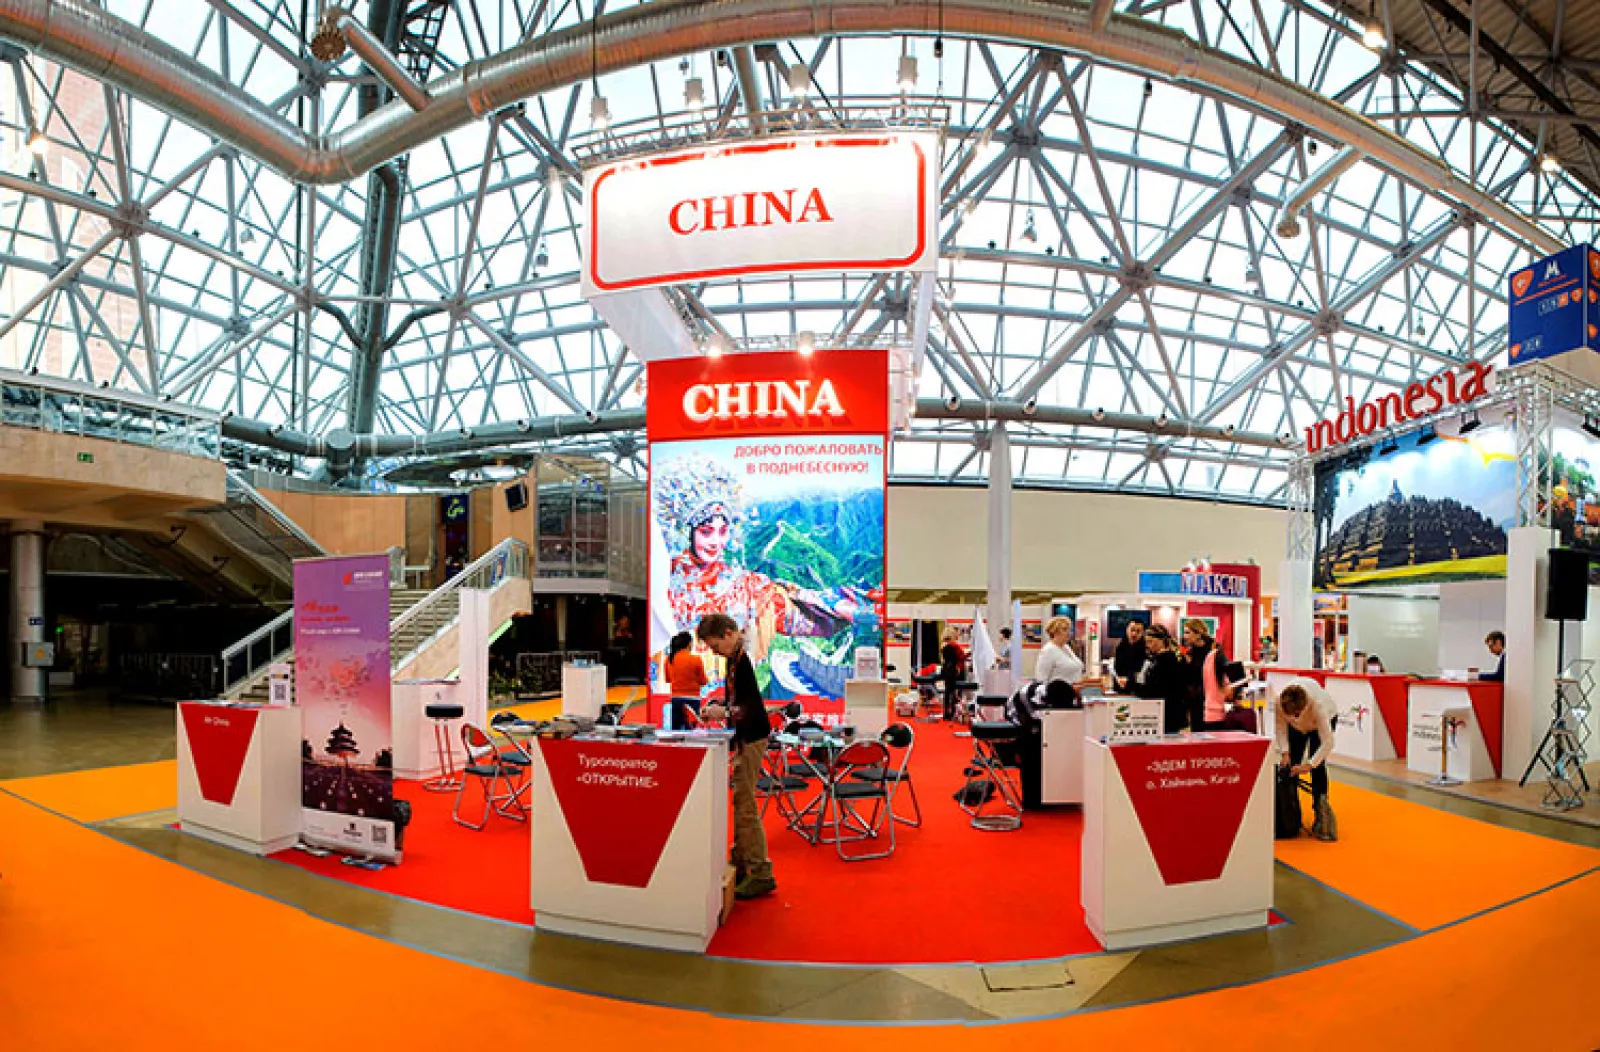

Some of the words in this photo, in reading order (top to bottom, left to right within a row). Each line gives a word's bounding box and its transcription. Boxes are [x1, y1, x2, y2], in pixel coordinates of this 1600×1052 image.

[668, 187, 834, 236] CHINA
[682, 377, 847, 423] CHINA
[1303, 361, 1494, 453] indonesia
[734, 445, 782, 459] ДОБРО
[784, 443, 883, 455] ПОЖАЛОВАТЬ
[746, 462, 756, 475] В
[759, 461, 869, 476] ПОДНЕБЕСНУЮ!
[578, 752, 658, 771] Туроператор
